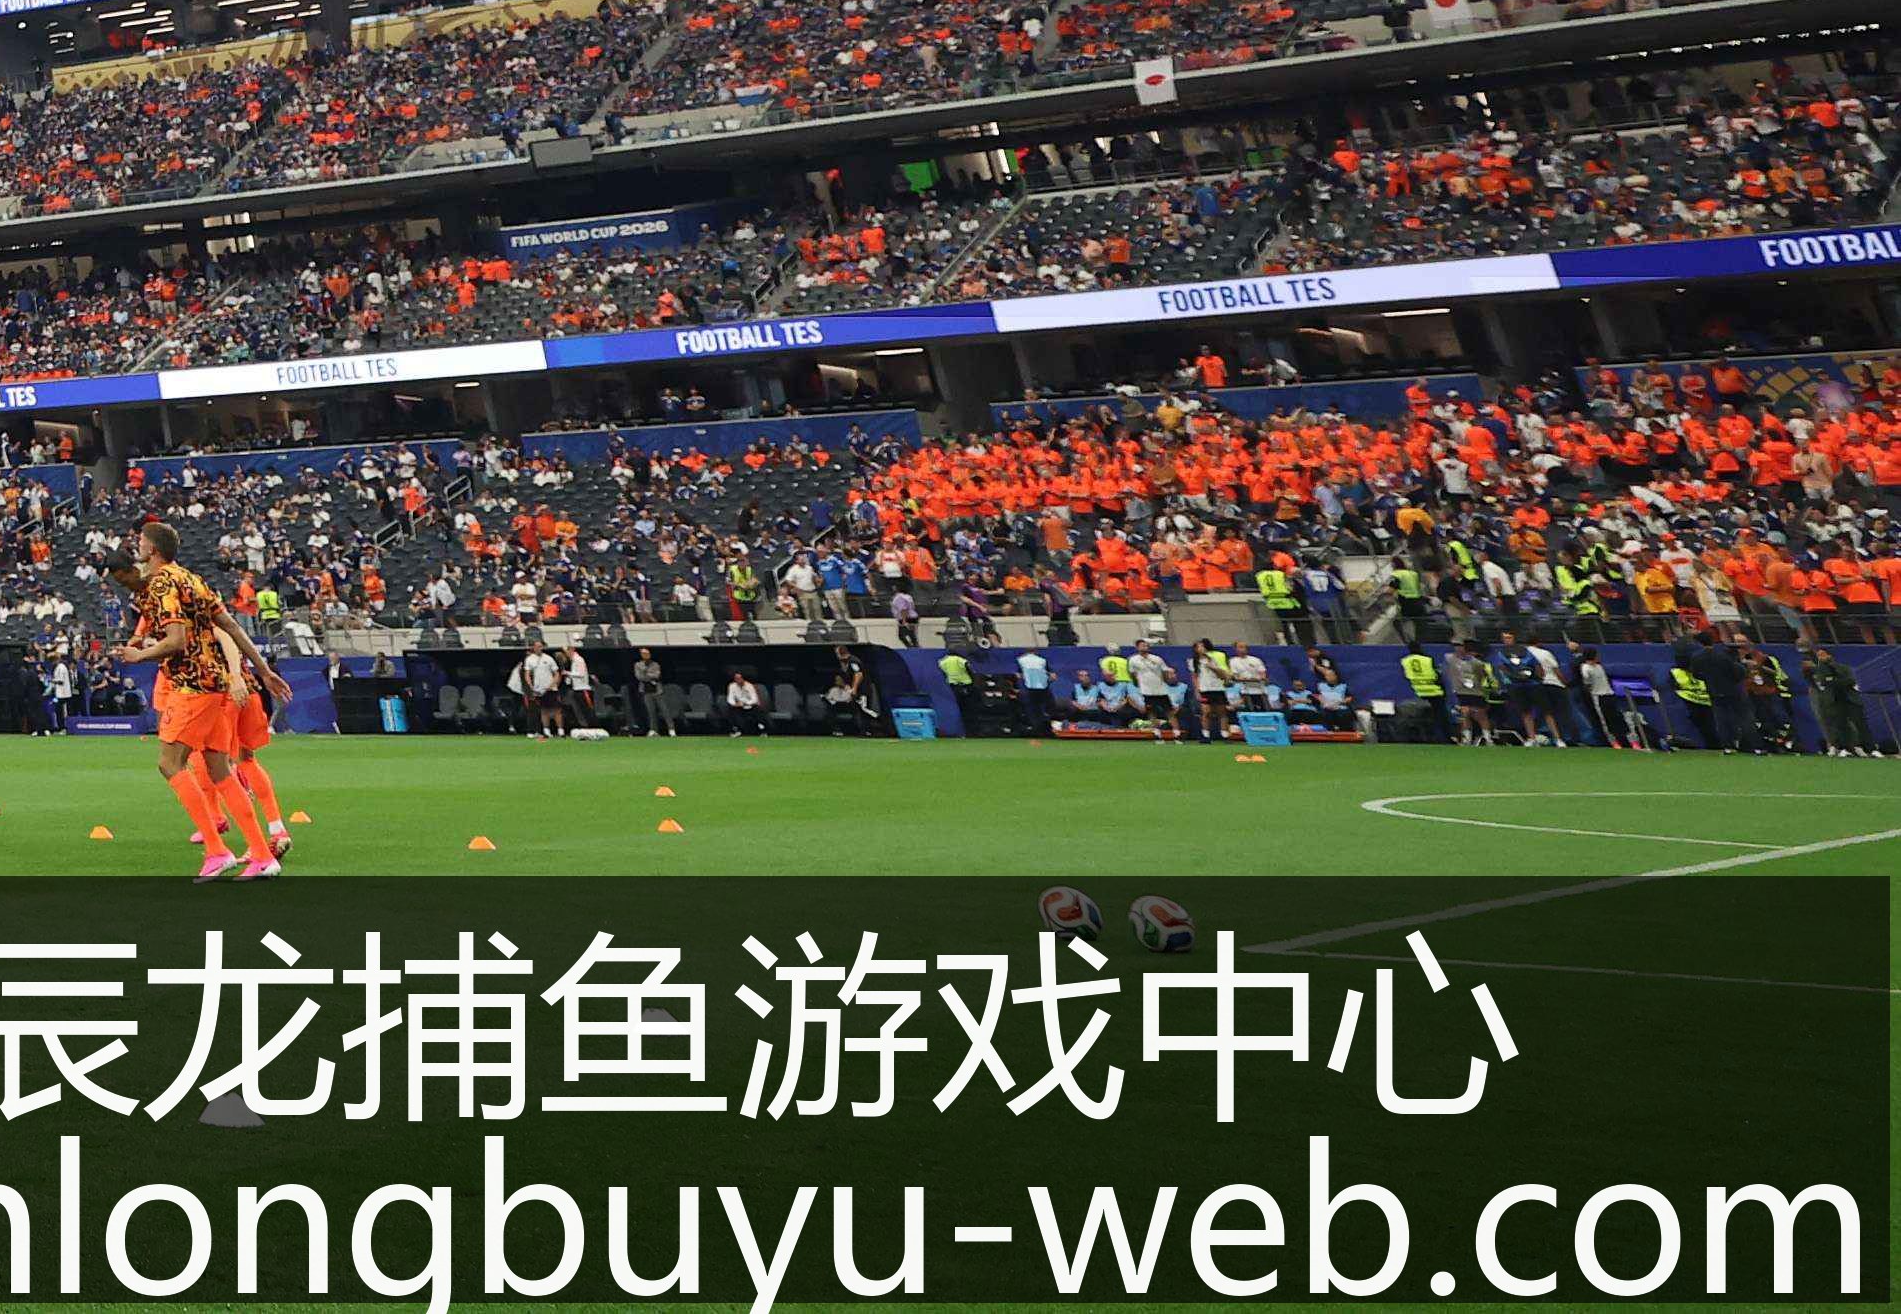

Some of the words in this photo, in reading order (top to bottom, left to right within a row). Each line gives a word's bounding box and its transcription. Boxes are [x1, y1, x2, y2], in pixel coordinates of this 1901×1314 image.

[510, 234, 540, 248] FIFA
[541, 228, 589, 244] WORLD
[590, 225, 618, 239] CUP
[619, 220, 669, 237] 2026
[1158, 282, 1282, 313] FOOTBALL
[677, 324, 779, 354] FOOTBALL
[277, 359, 361, 384] FOOTBALL
